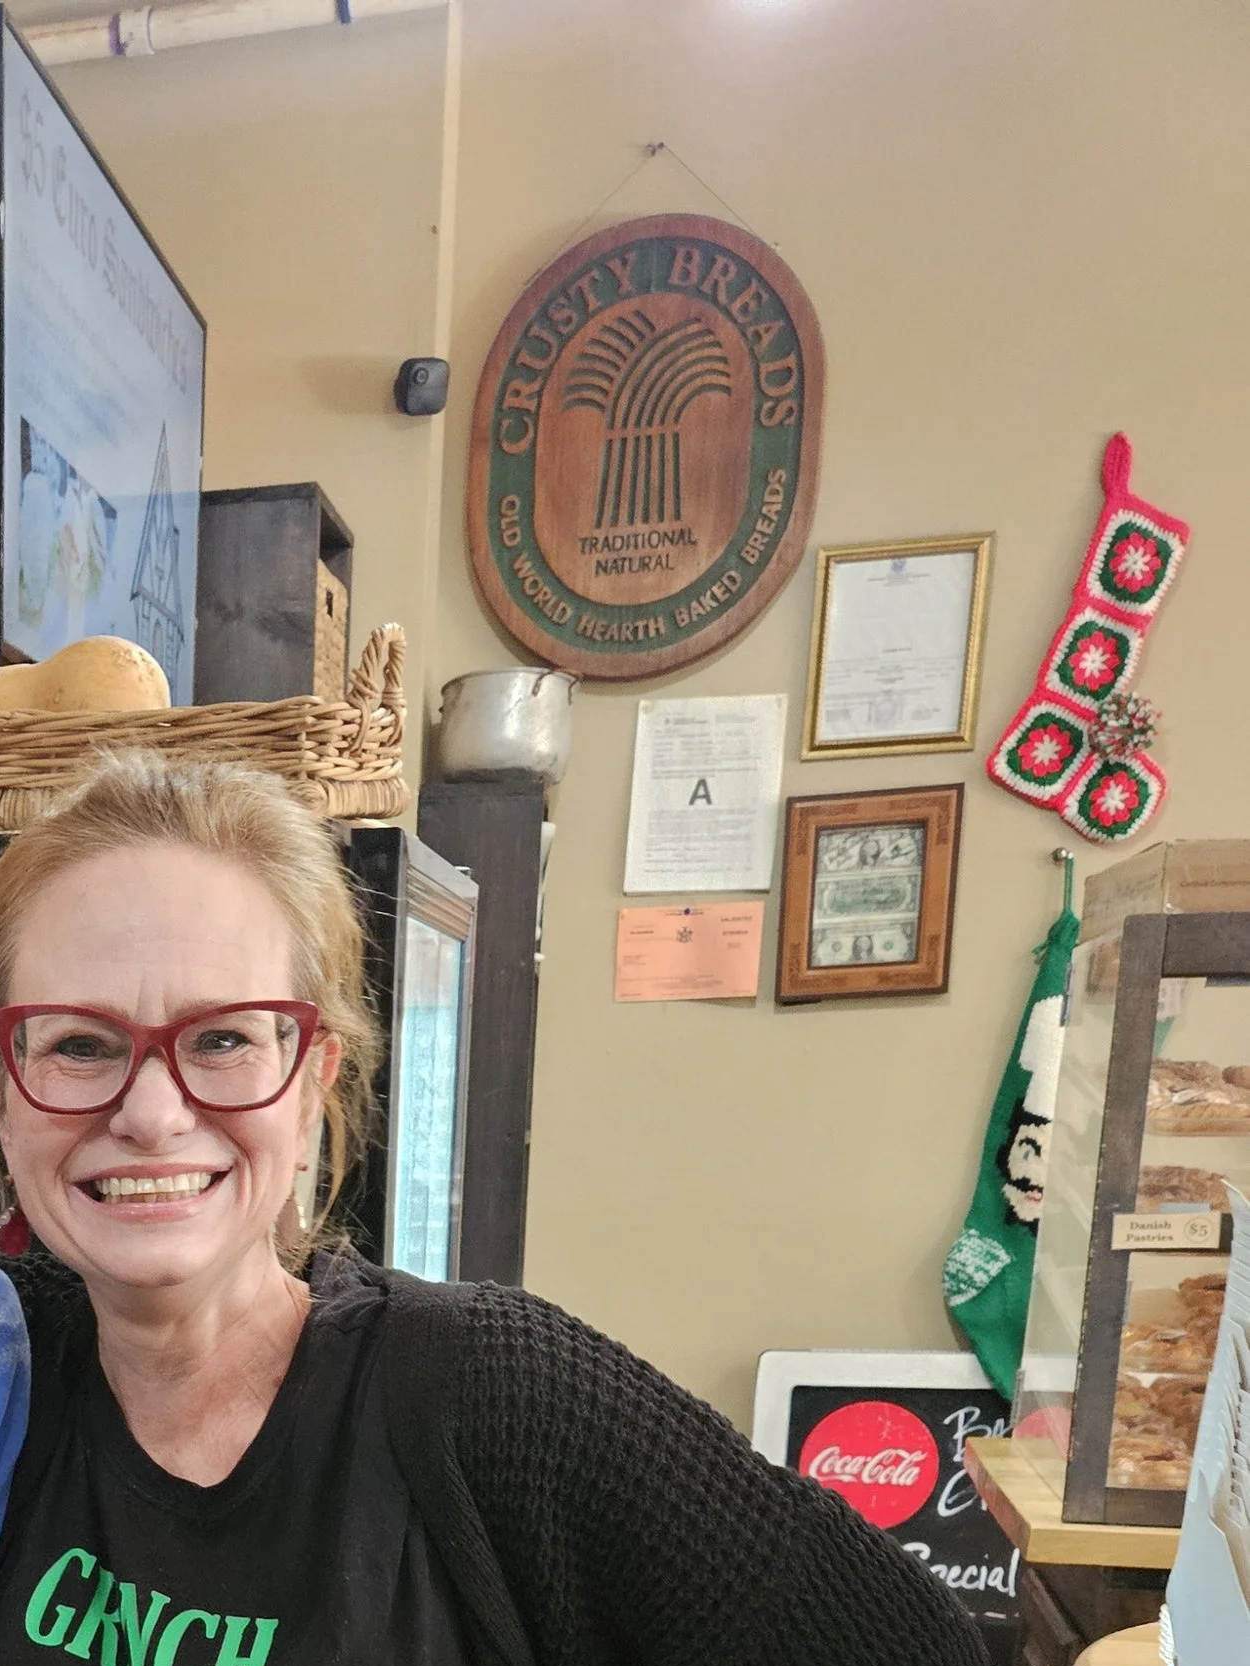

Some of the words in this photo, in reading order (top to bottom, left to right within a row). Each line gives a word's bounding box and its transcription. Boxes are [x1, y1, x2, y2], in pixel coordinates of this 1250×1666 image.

[501, 249, 637, 456] CRUSTY
[668, 247, 797, 428] BREADS
[501, 495, 522, 548] OLD
[512, 552, 573, 626] WORLD
[575, 614, 666, 642] HEARTH
[673, 569, 742, 629] BAKED
[741, 467, 787, 566] BREADS
[578, 527, 698, 556] TRADITIONAL
[594, 552, 675, 577] NATURAL
[688, 777, 712, 806] A
[1126, 1232, 1174, 1242] Pastries
[1129, 1221, 1172, 1231] Danish
[1189, 1222, 1208, 1238] $5
[808, 1446, 927, 1486] Coca-Cola
